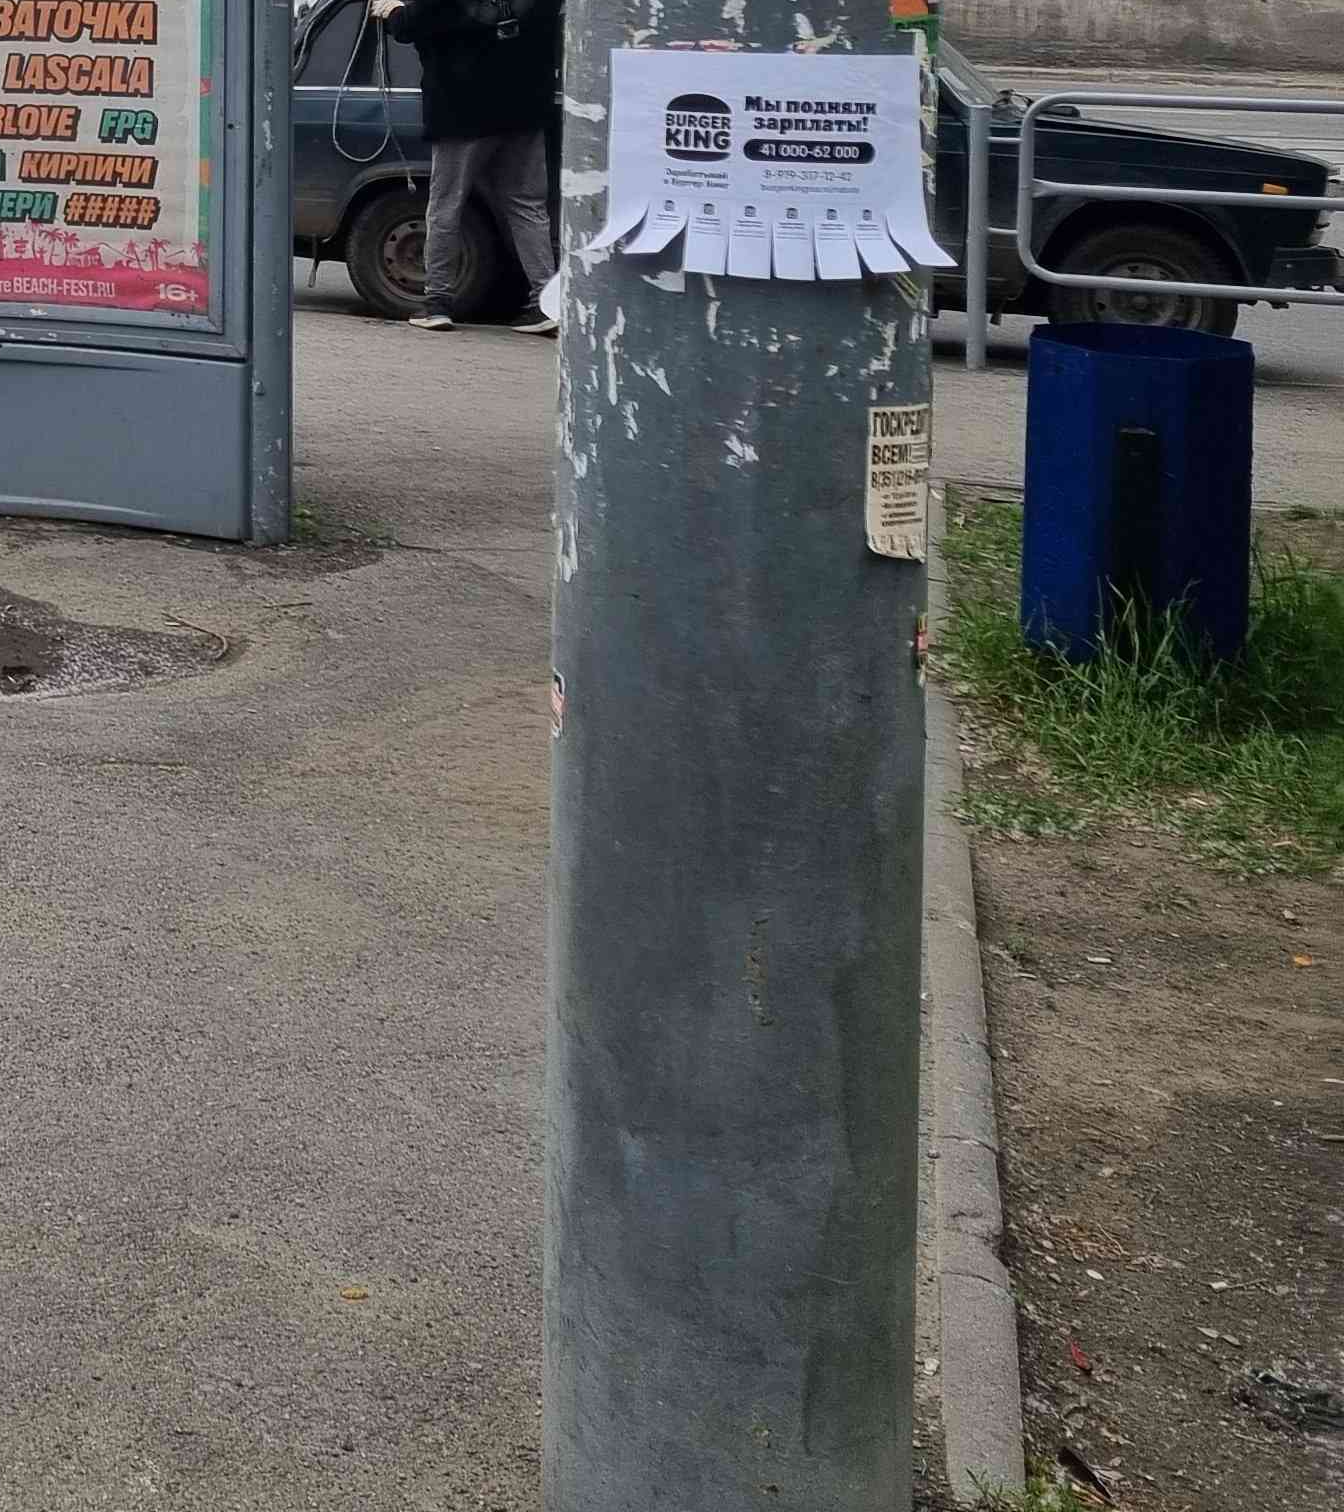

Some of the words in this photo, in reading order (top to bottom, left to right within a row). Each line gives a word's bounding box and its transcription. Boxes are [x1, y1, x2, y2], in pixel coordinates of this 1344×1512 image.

[2, 53, 153, 97] LASCALA
[744, 95, 781, 112] Мы
[785, 99, 877, 115] подняли
[98, 108, 158, 145] FPG
[665, 113, 732, 130] BURGER
[753, 116, 869, 135] зарплаты!
[665, 128, 731, 150] KING
[760, 143, 776, 156] 41
[833, 146, 860, 159] 000
[18, 150, 158, 188] КИРПИЧИ
[14, 277, 115, 297] BEACH-FEST.RU
[159, 283, 199, 302] 16+
